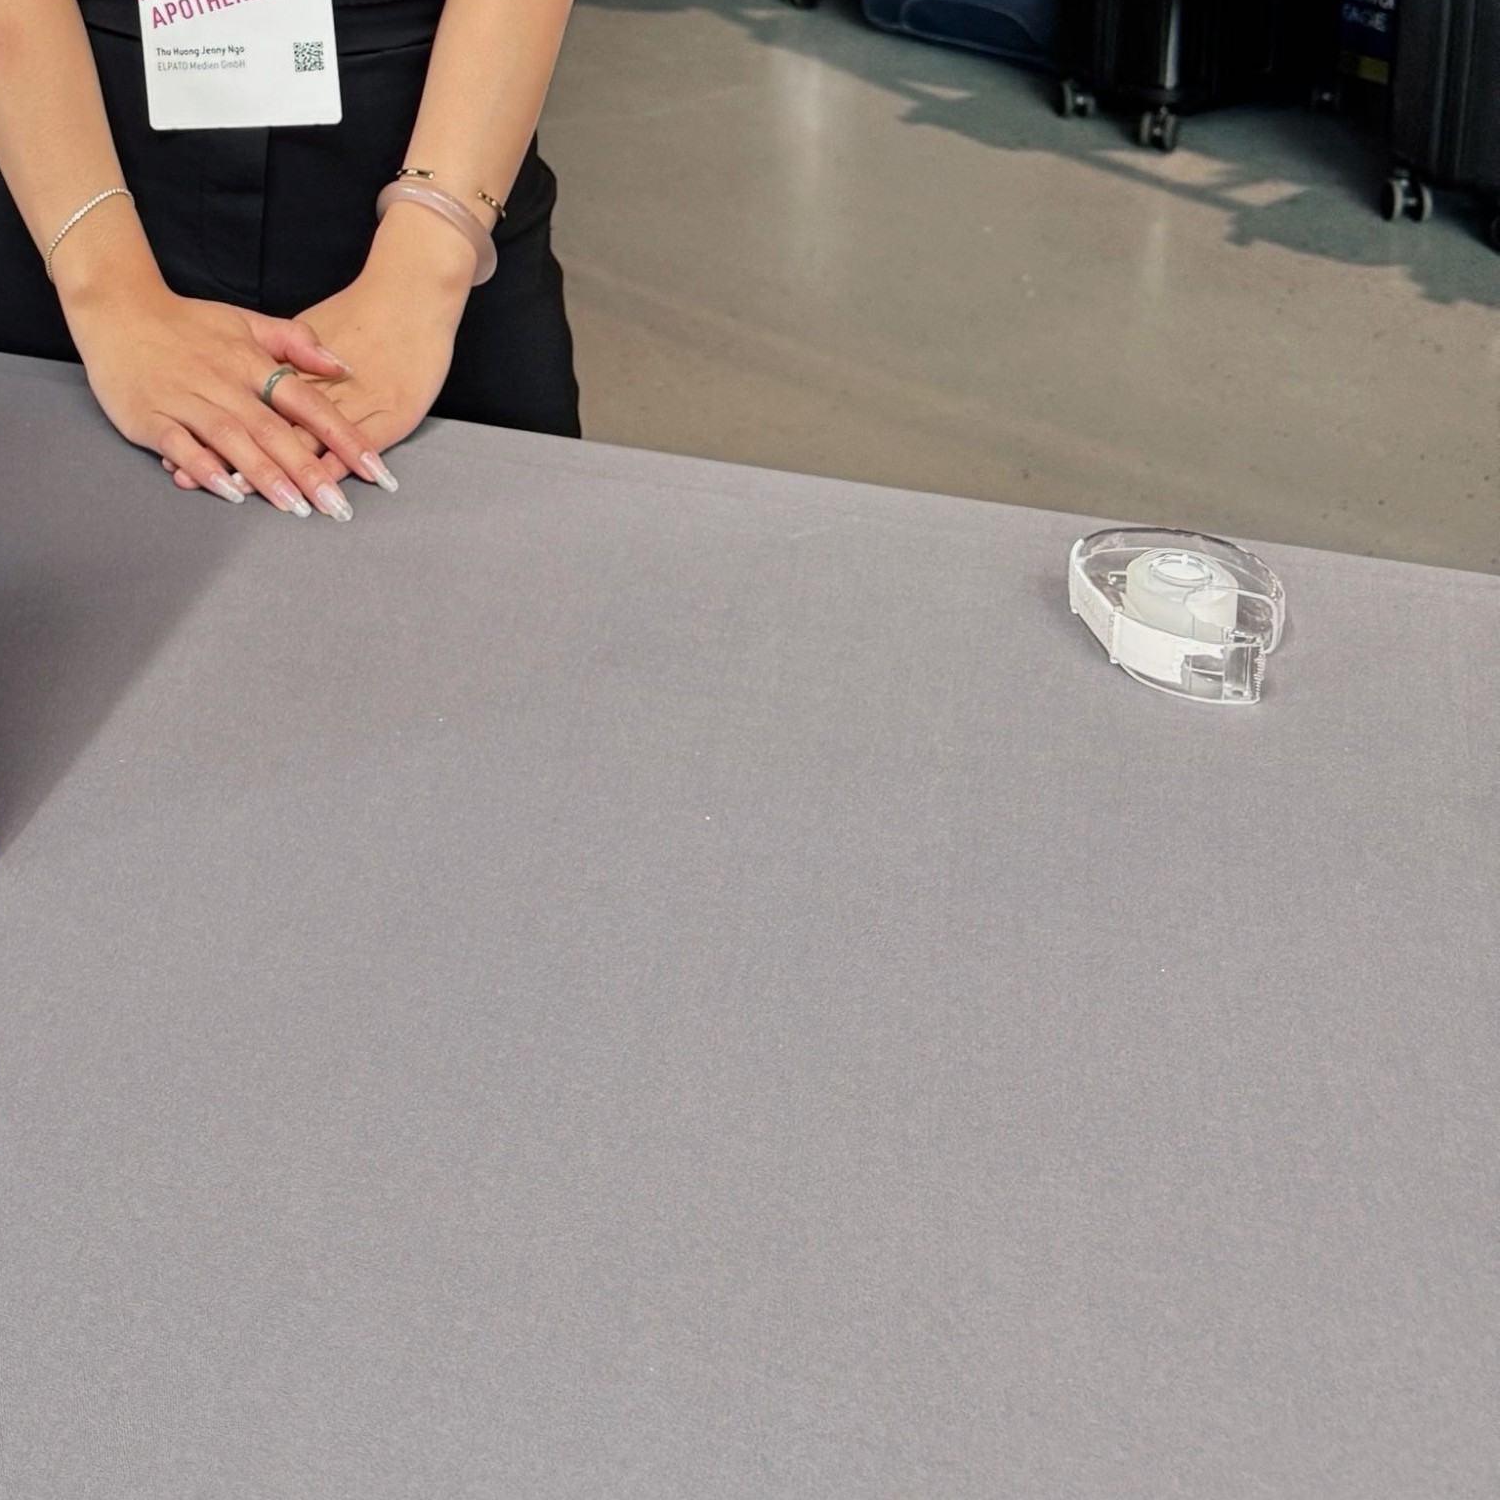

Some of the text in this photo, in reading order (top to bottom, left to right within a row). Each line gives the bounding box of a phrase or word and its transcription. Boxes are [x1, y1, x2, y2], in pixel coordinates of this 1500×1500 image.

[156, 47, 172, 56] Thu
[202, 46, 226, 57] Jenny
[157, 61, 189, 72] ELPATO
